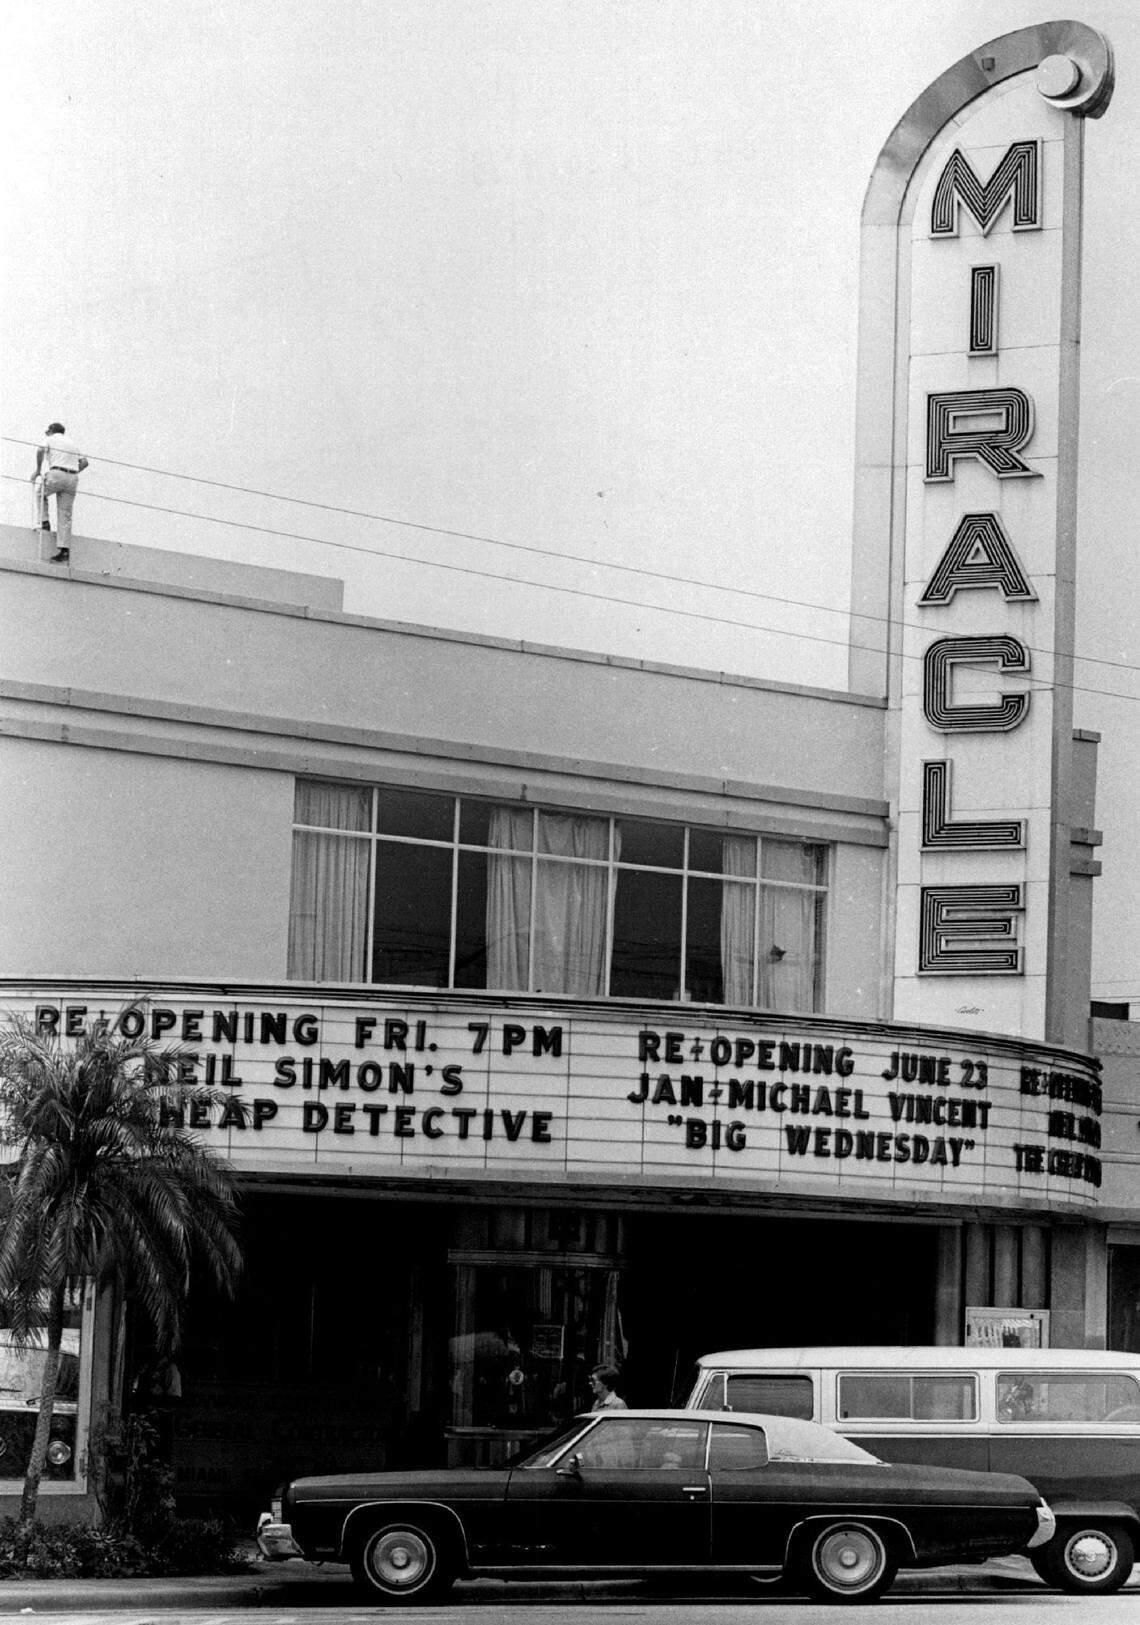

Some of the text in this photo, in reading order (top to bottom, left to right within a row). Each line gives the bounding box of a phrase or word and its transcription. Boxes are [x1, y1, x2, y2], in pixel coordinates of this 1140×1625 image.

[915, 137, 1043, 976] MIRACLE
[35, 1004, 563, 1058] RE-OPENING FRI. 7 PM
[274, 1056, 464, 1095] SIMON'S
[638, 1030, 988, 1090] RE-OPENING JUNE 23
[158, 1095, 553, 1143] HEAP DETECTIVE
[627, 1073, 992, 1130] JAN-MICHAEL VINCENT
[667, 1114, 975, 1167] "BIG WEDNESDAY"
